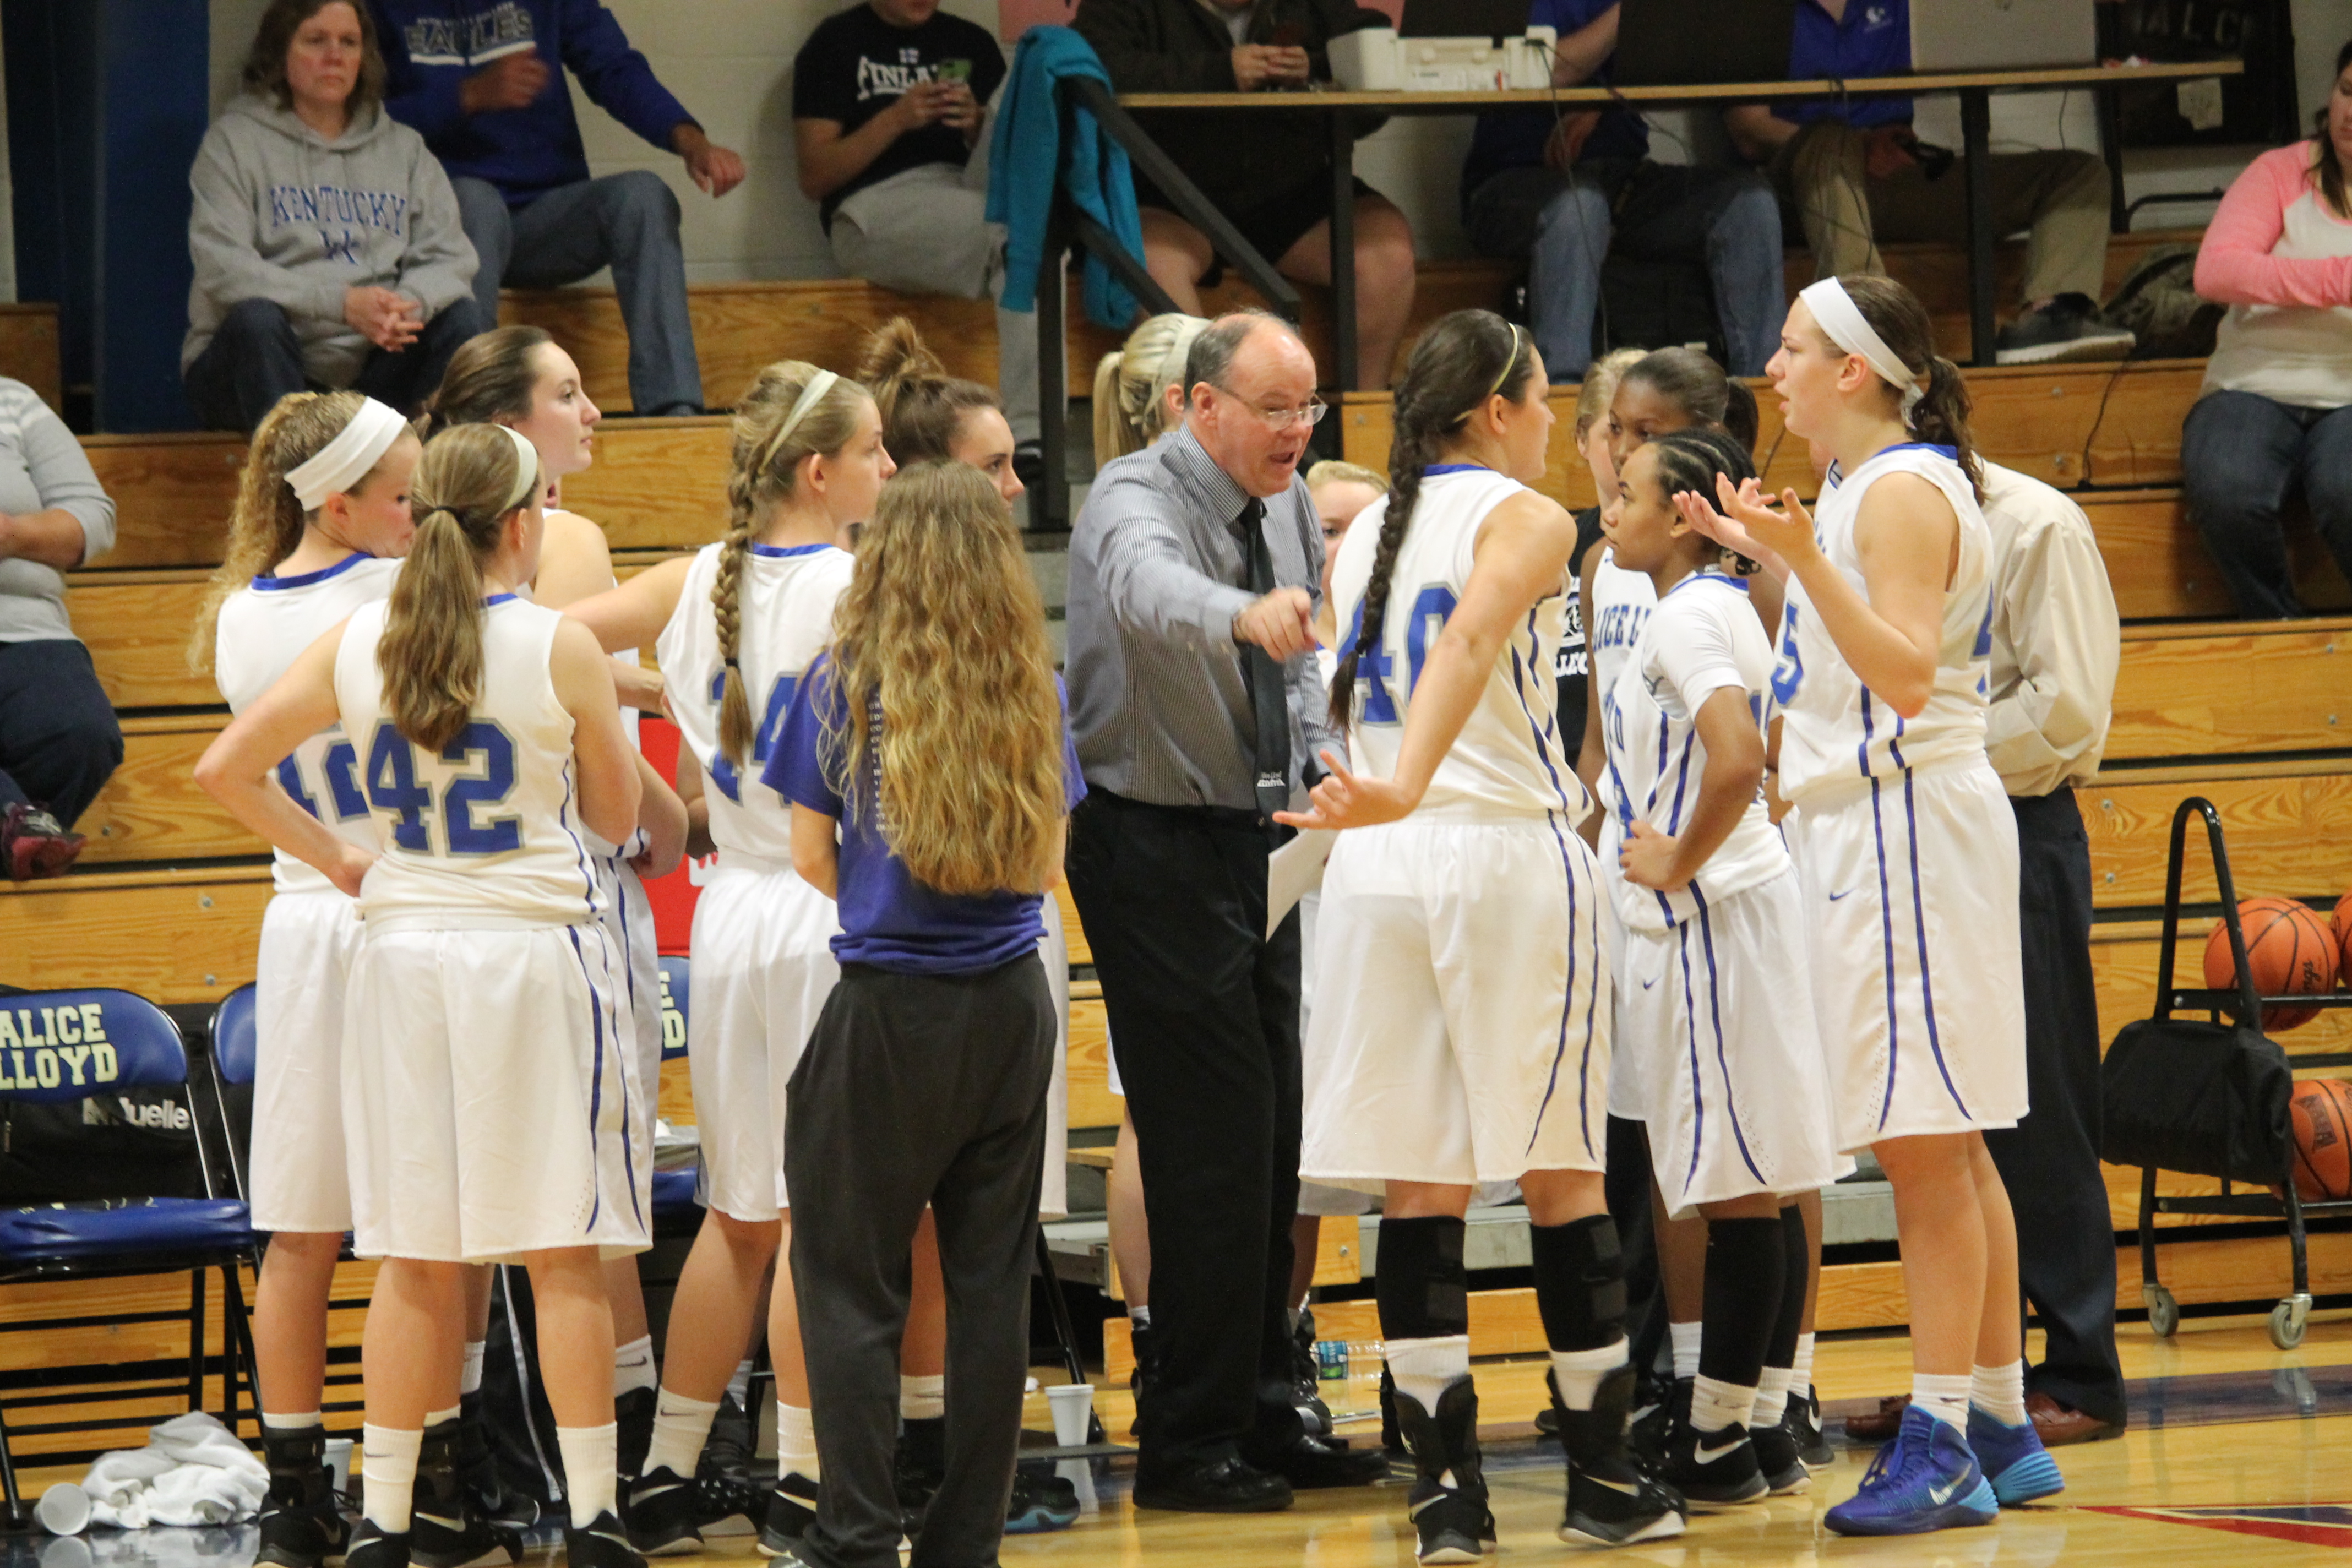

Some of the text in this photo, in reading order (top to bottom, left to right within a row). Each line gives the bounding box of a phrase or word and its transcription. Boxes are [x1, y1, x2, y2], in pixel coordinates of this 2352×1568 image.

[404, 2, 533, 55] EALES
[857, 55, 938, 100] FINLA
[269, 186, 406, 236] KENTUCKY
[367, 717, 526, 859] 42
[0, 1003, 107, 1048] ALICE
